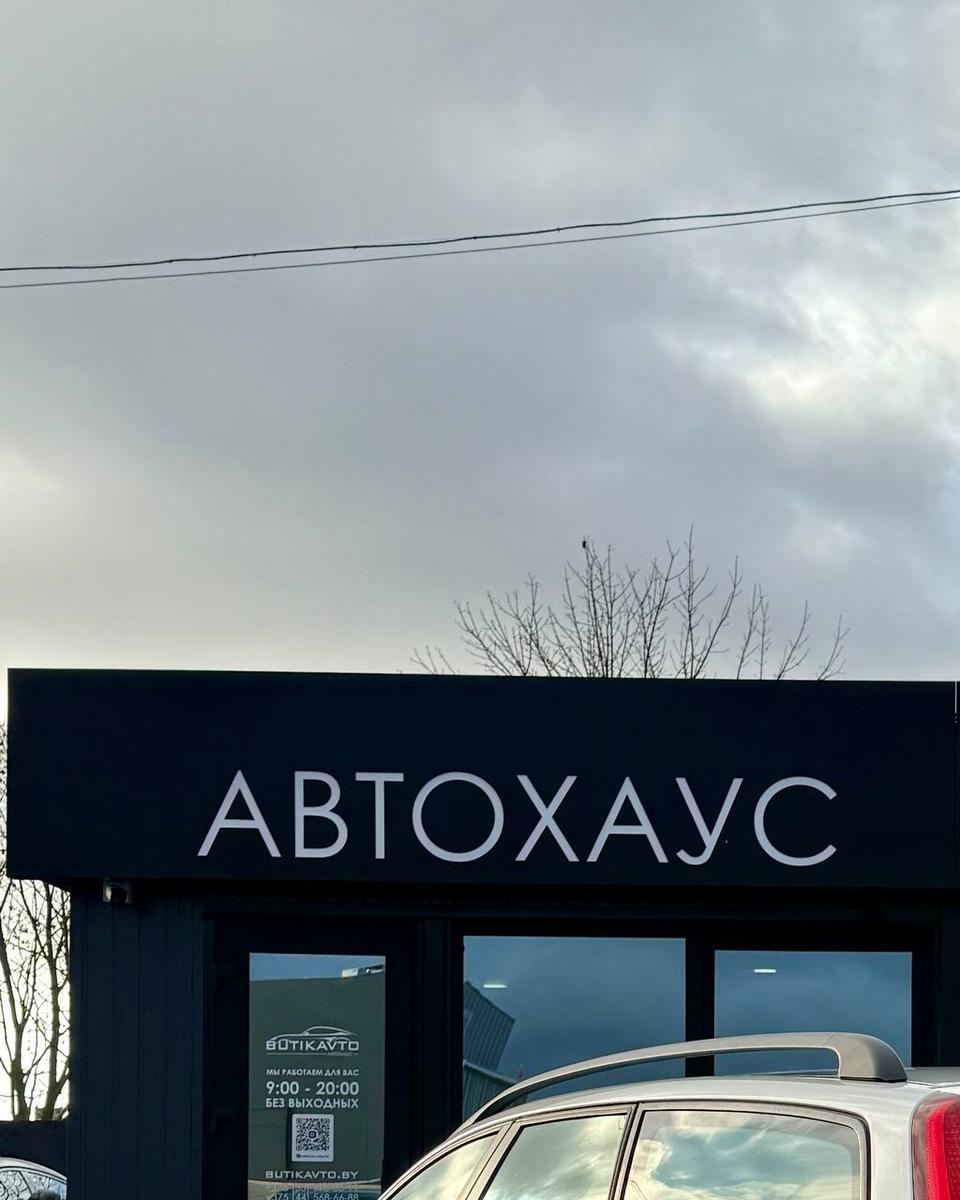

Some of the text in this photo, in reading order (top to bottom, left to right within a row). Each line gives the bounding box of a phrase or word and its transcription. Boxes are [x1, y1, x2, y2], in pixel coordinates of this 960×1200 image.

[197, 769, 838, 867] АВТОХАУС
[266, 1040, 360, 1051] BUTIKAVTO
[324, 1069, 341, 1077] ДЛЯ
[266, 1081, 300, 1095] 9:00
[316, 1081, 359, 1095] 20:00
[266, 1098, 359, 1109] БЕЗ ВЫХОДНЫХ
[265, 1170, 359, 1179] BUTIKAVTO.BY
